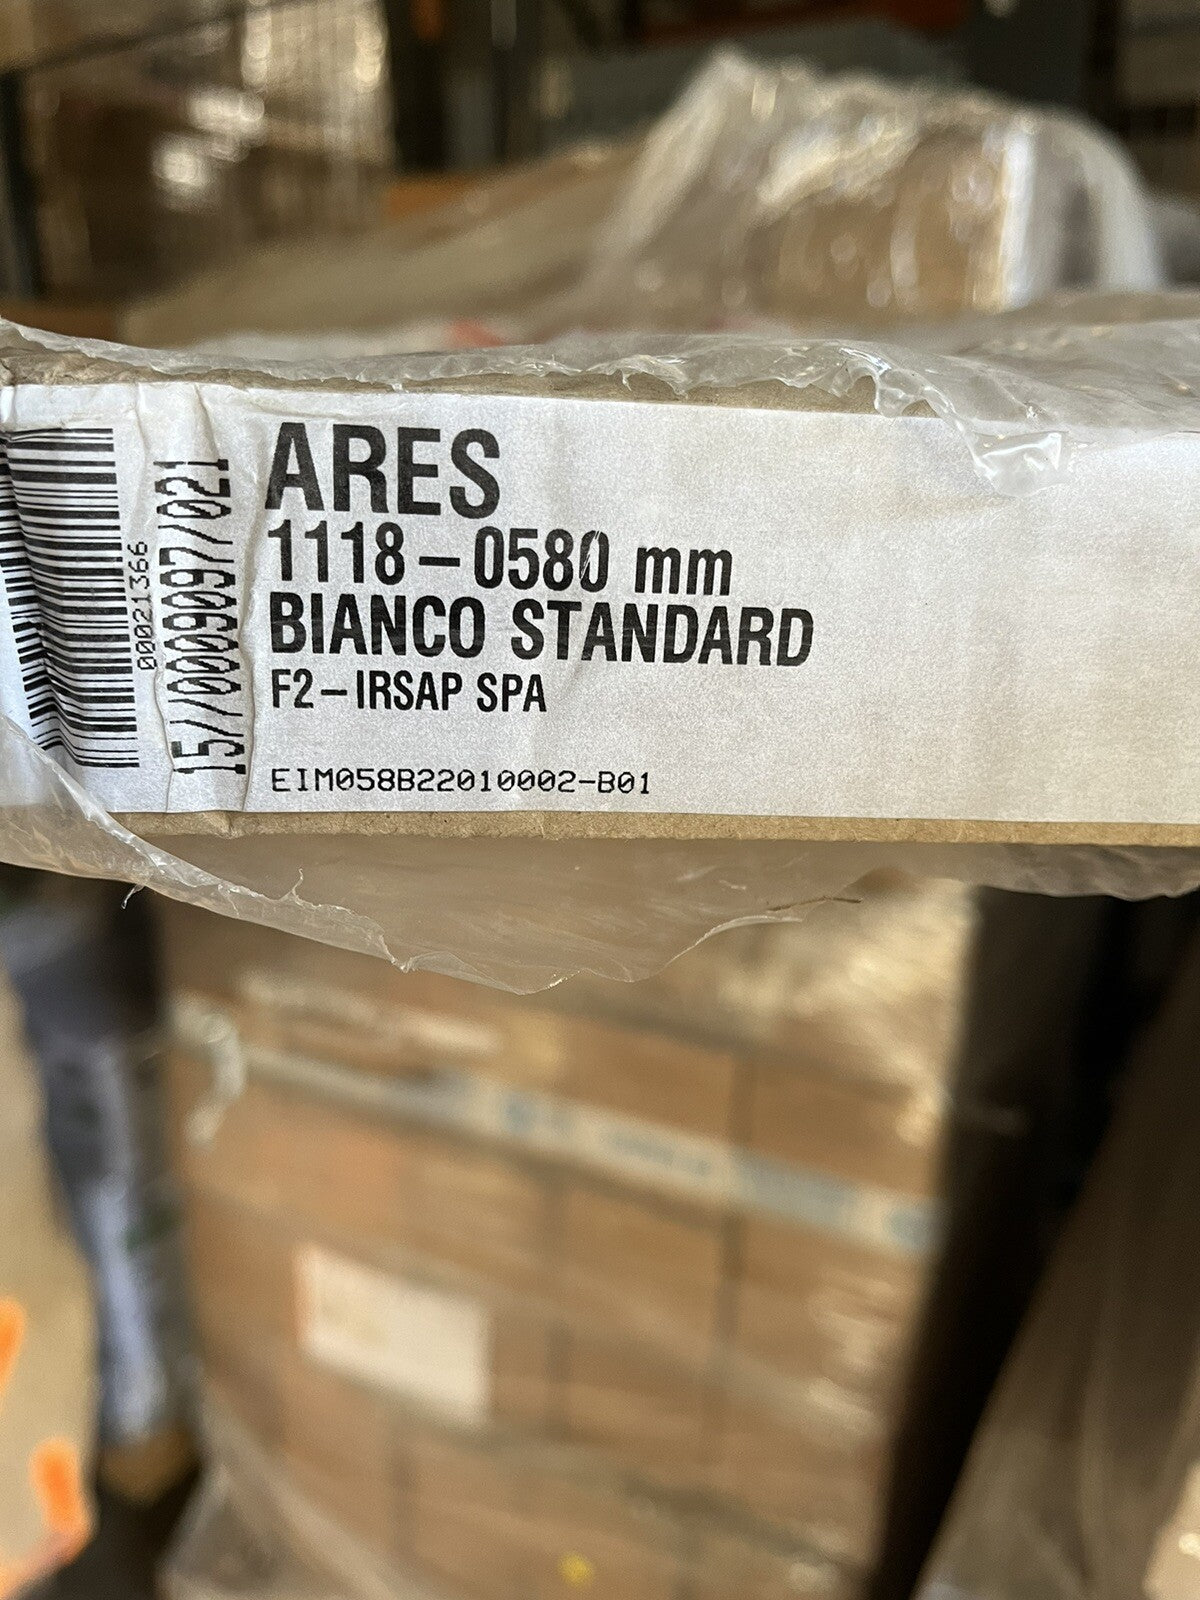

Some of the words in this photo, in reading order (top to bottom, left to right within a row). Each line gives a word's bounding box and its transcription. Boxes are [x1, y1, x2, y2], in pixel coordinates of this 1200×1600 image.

[265, 422, 500, 518] ARES
[127, 541, 155, 670] 00021366
[635, 547, 733, 596] mm
[153, 459, 247, 775] 15//0009097/021
[270, 592, 485, 658] BIANCO
[512, 599, 814, 666] STANDARD
[477, 674, 546, 713] SPA
[272, 769, 651, 794] EIM058B22010002-B01
